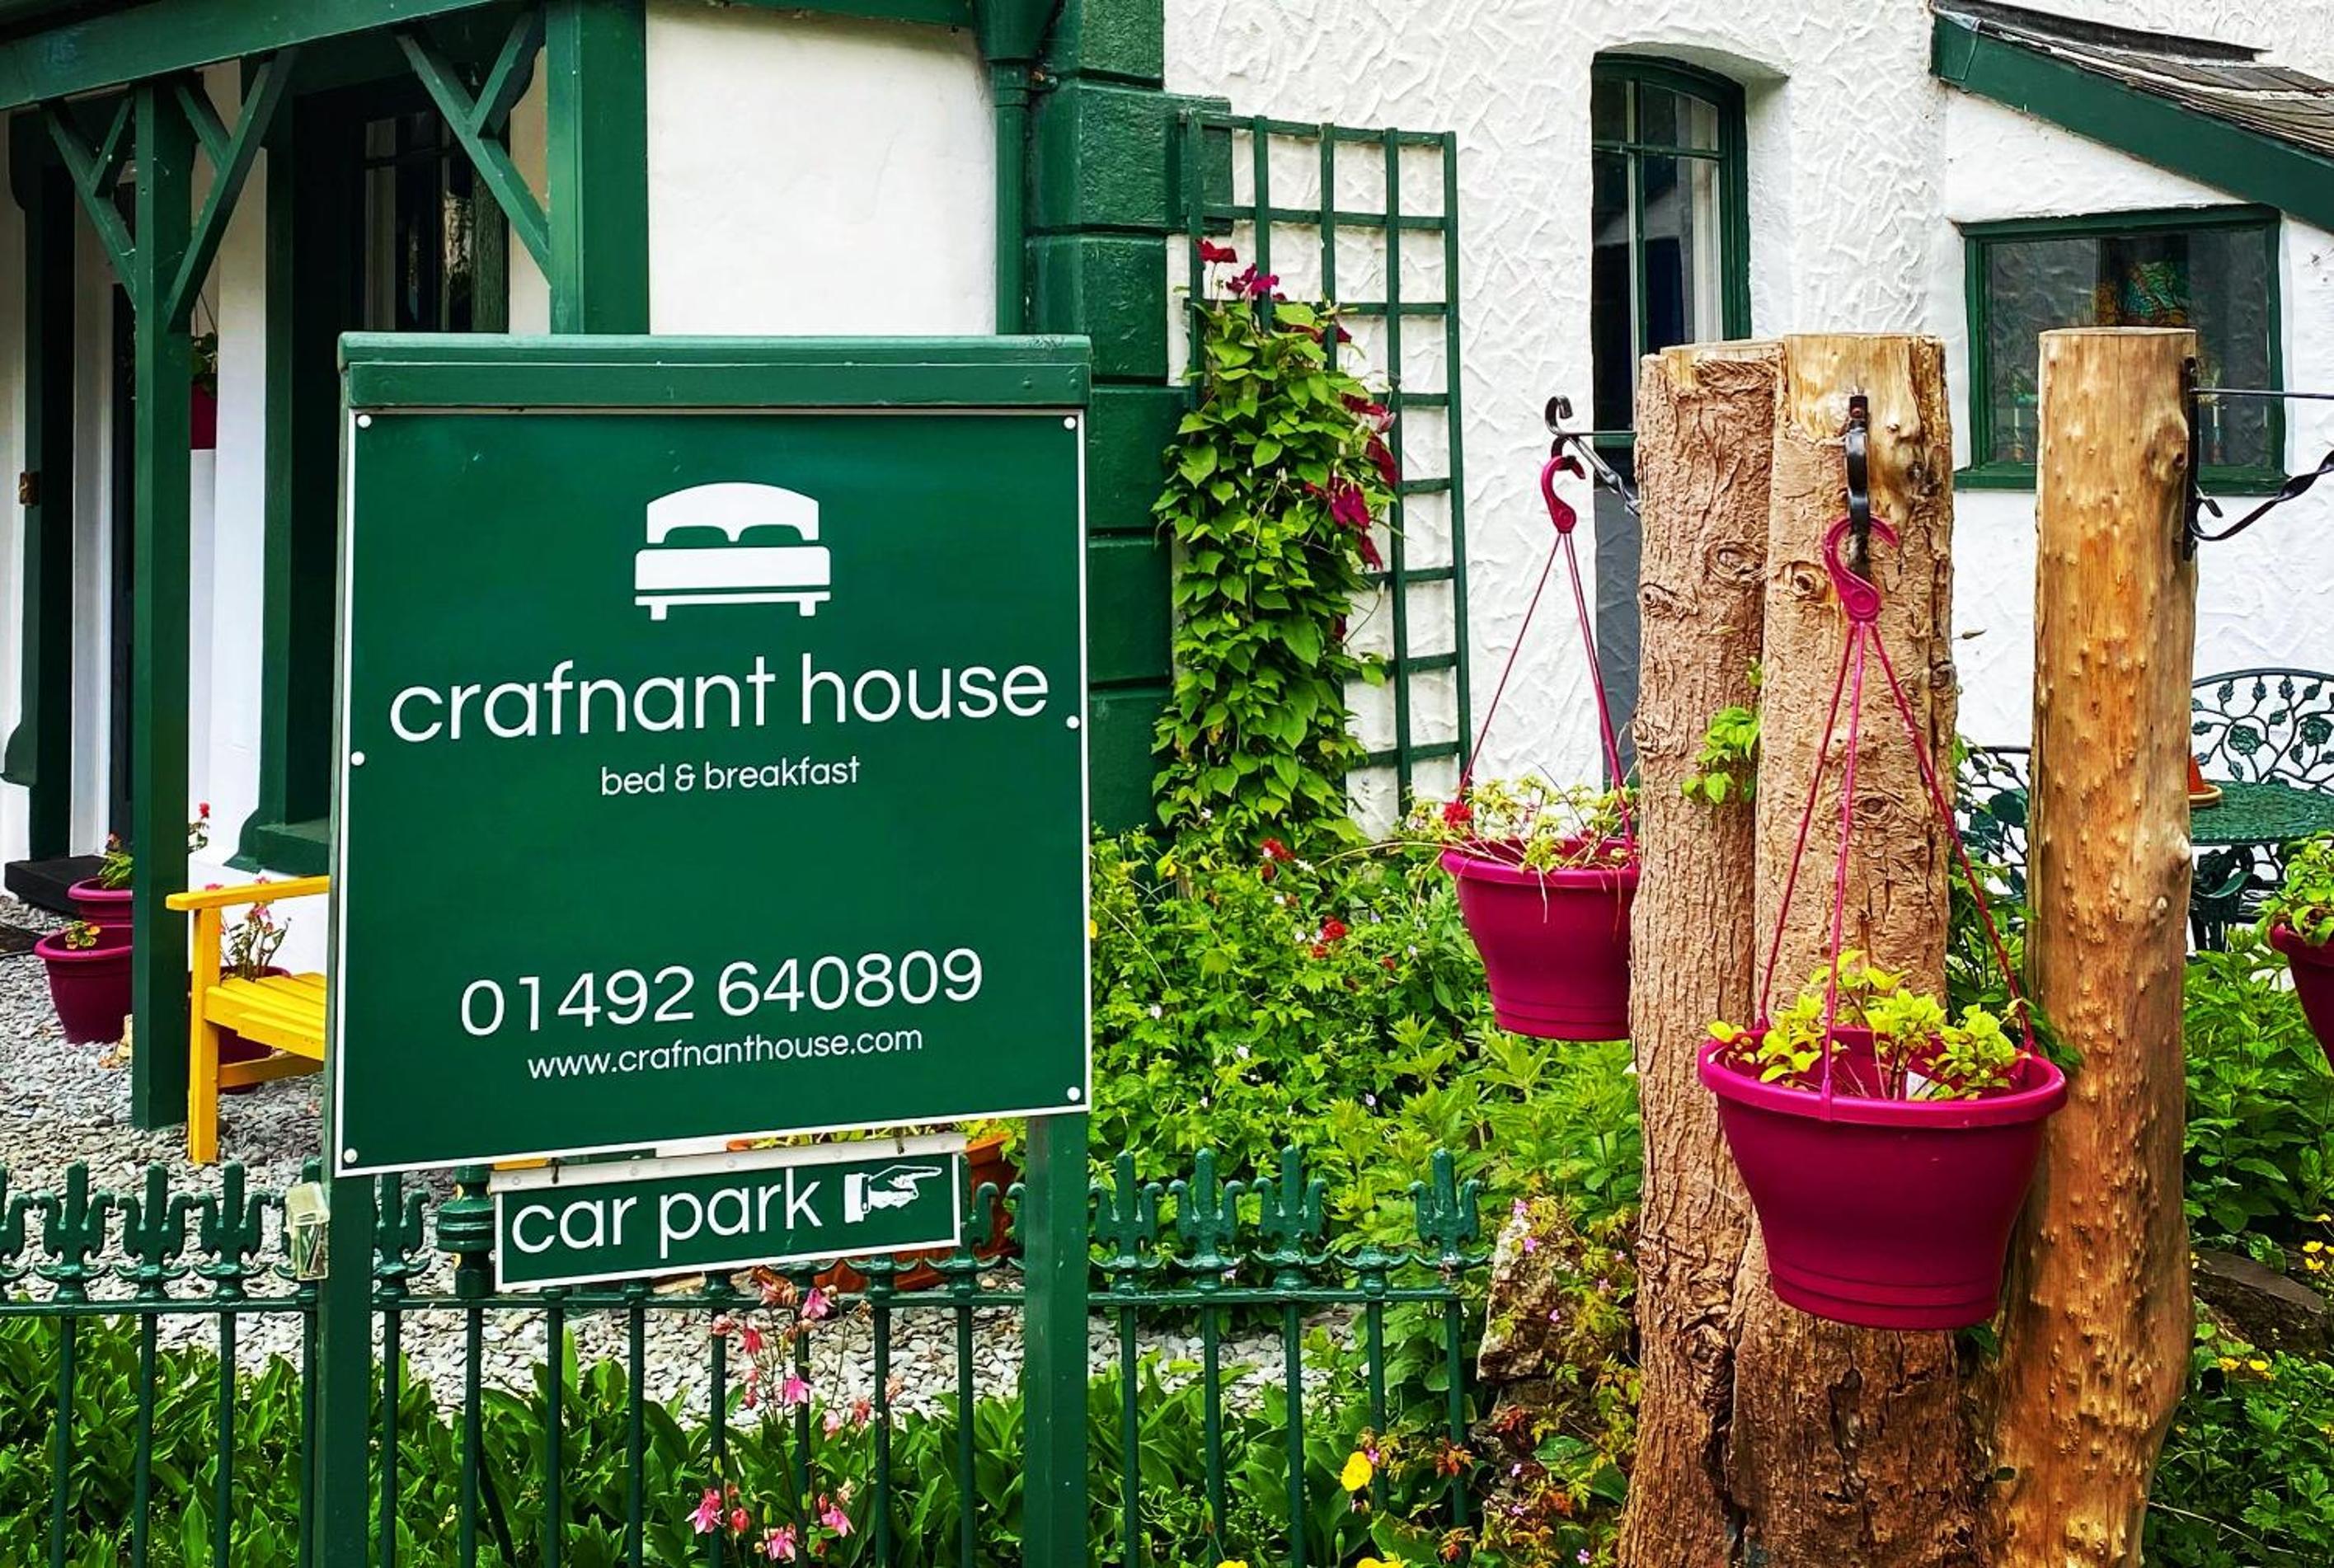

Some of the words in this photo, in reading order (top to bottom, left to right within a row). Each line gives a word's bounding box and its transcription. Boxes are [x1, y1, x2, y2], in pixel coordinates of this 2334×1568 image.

[389, 655, 777, 743] crafnant
[801, 652, 1049, 725] house
[601, 763, 665, 796] bed
[674, 763, 697, 792] &
[704, 754, 861, 791] breakfast
[461, 965, 695, 1036] 01492
[717, 947, 983, 1017] 640809
[527, 1028, 923, 1080] www.crafnanthouse.com
[511, 1195, 638, 1254] car
[659, 1167, 824, 1260] park
